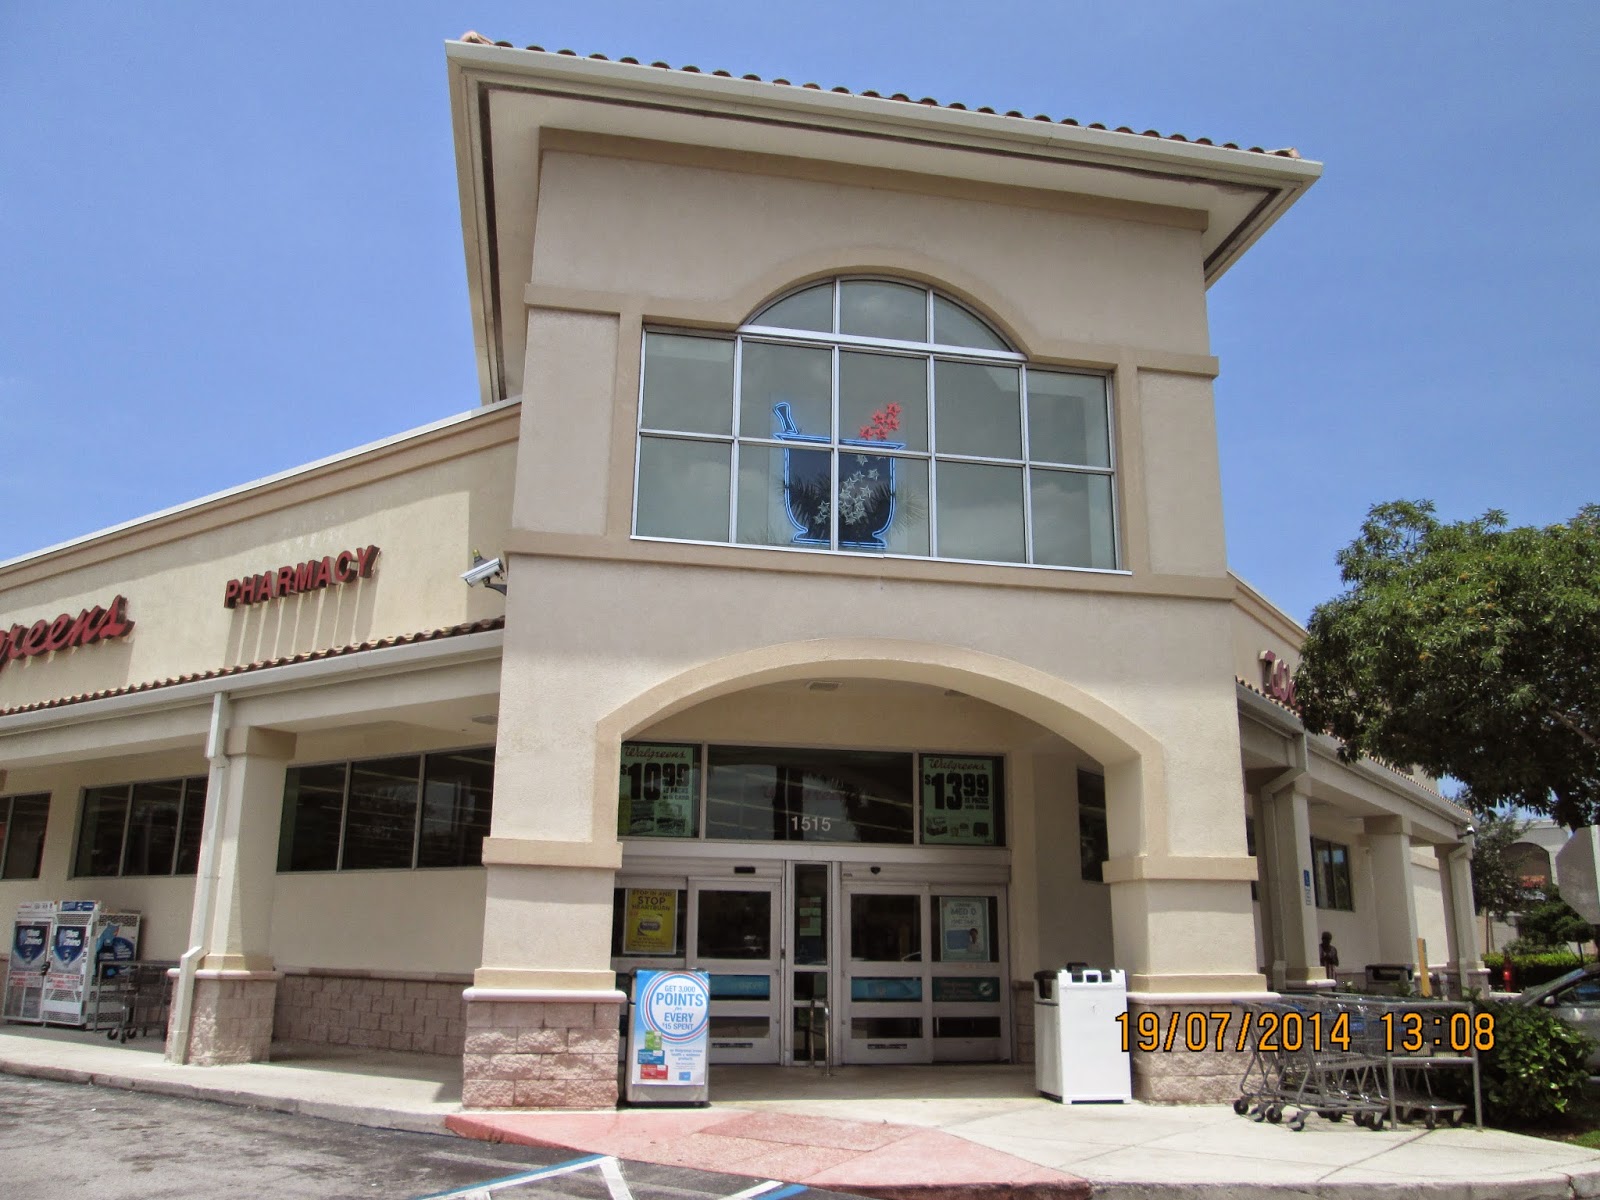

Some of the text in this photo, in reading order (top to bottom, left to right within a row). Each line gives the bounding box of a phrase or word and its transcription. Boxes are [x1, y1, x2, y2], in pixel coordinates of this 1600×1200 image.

[224, 545, 380, 609] PHARMACY
[624, 746, 687, 760] Walgreens
[928, 758, 986, 771] Walgreens
[791, 816, 831, 832] 1515
[638, 896, 666, 905] STOP
[678, 985, 696, 993] 3,000
[656, 992, 704, 1006] POINTS
[664, 1012, 694, 1022] EVERY
